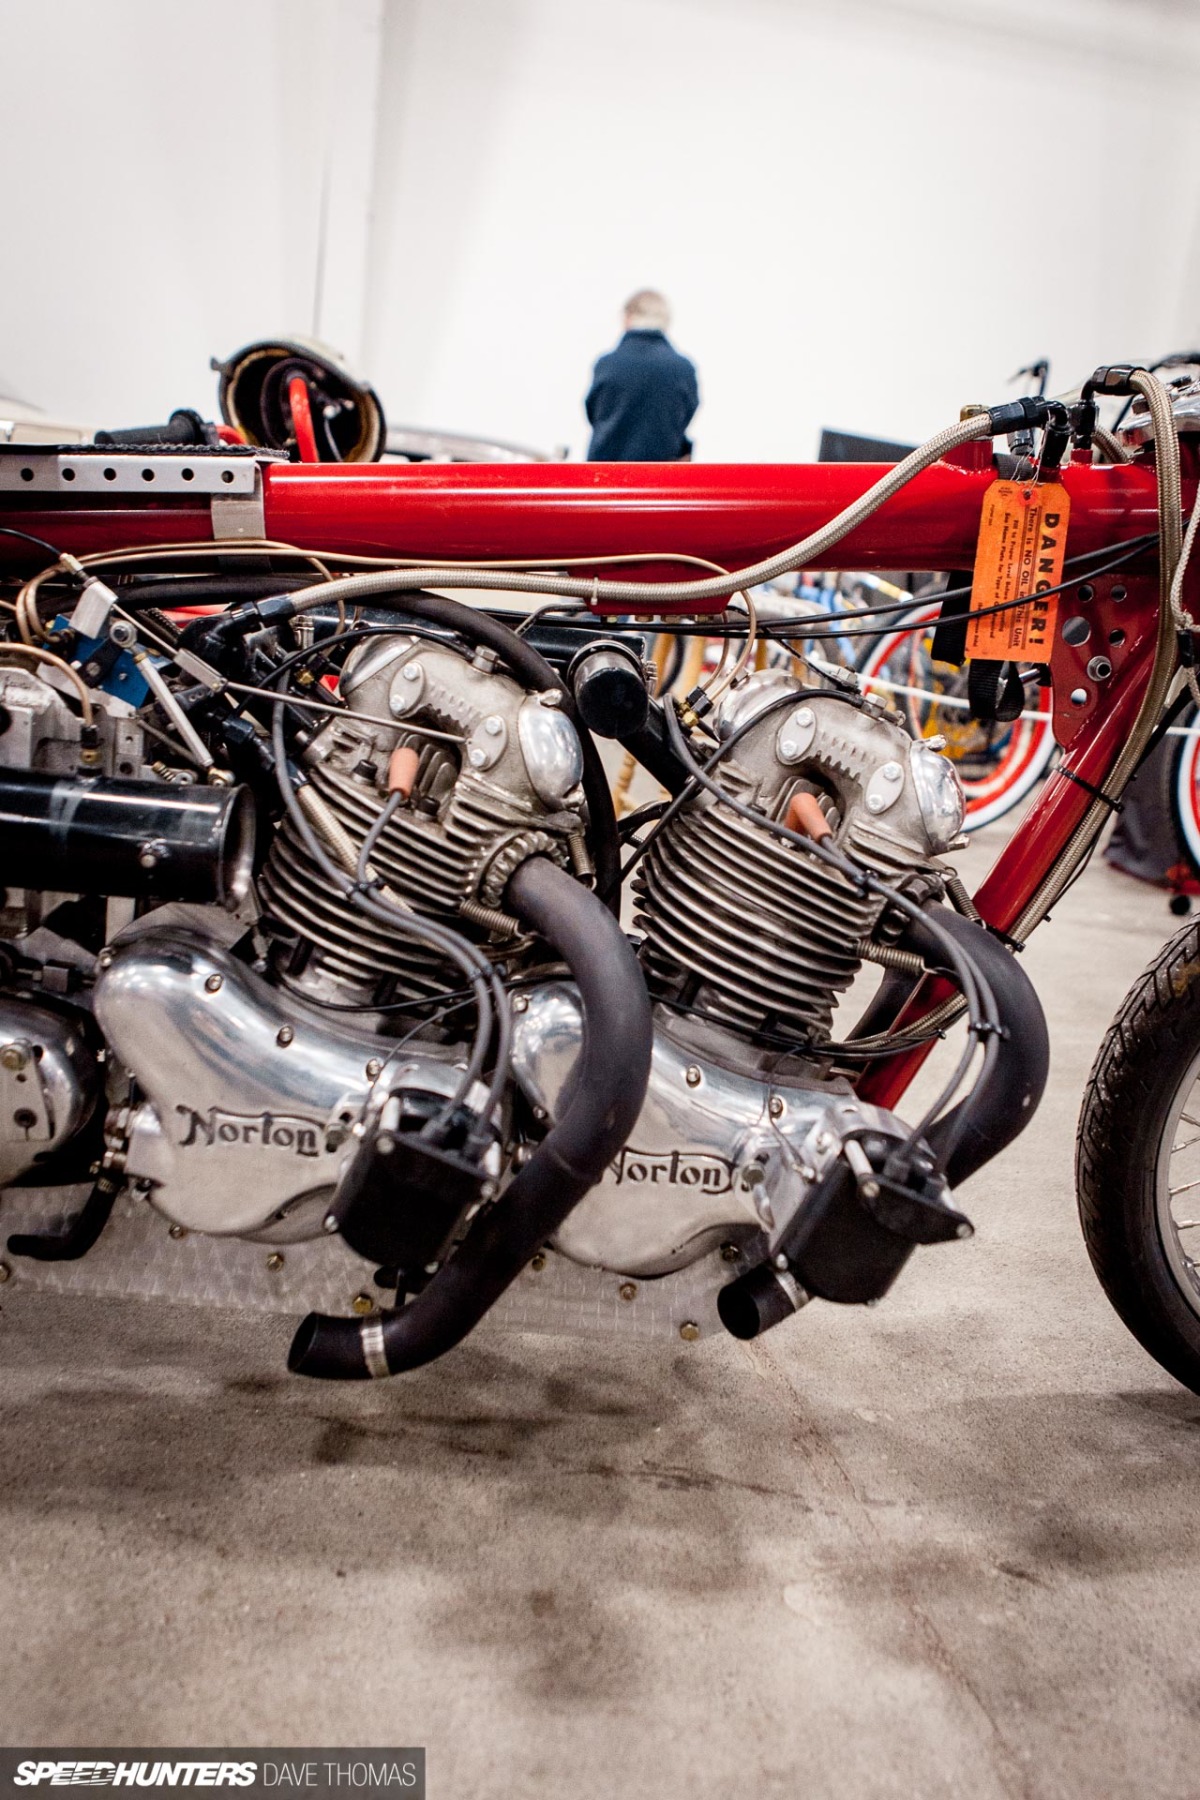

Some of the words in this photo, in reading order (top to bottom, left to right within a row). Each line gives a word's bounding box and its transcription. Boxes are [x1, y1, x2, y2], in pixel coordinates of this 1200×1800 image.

[1027, 507, 1038, 533] There
[1026, 537, 1034, 545] is
[1024, 550, 1033, 566] NO
[1021, 571, 1030, 587] OIL
[1029, 513, 1060, 645] DANGER!
[1013, 628, 1023, 647] Unit
[176, 1104, 326, 1157] Norton
